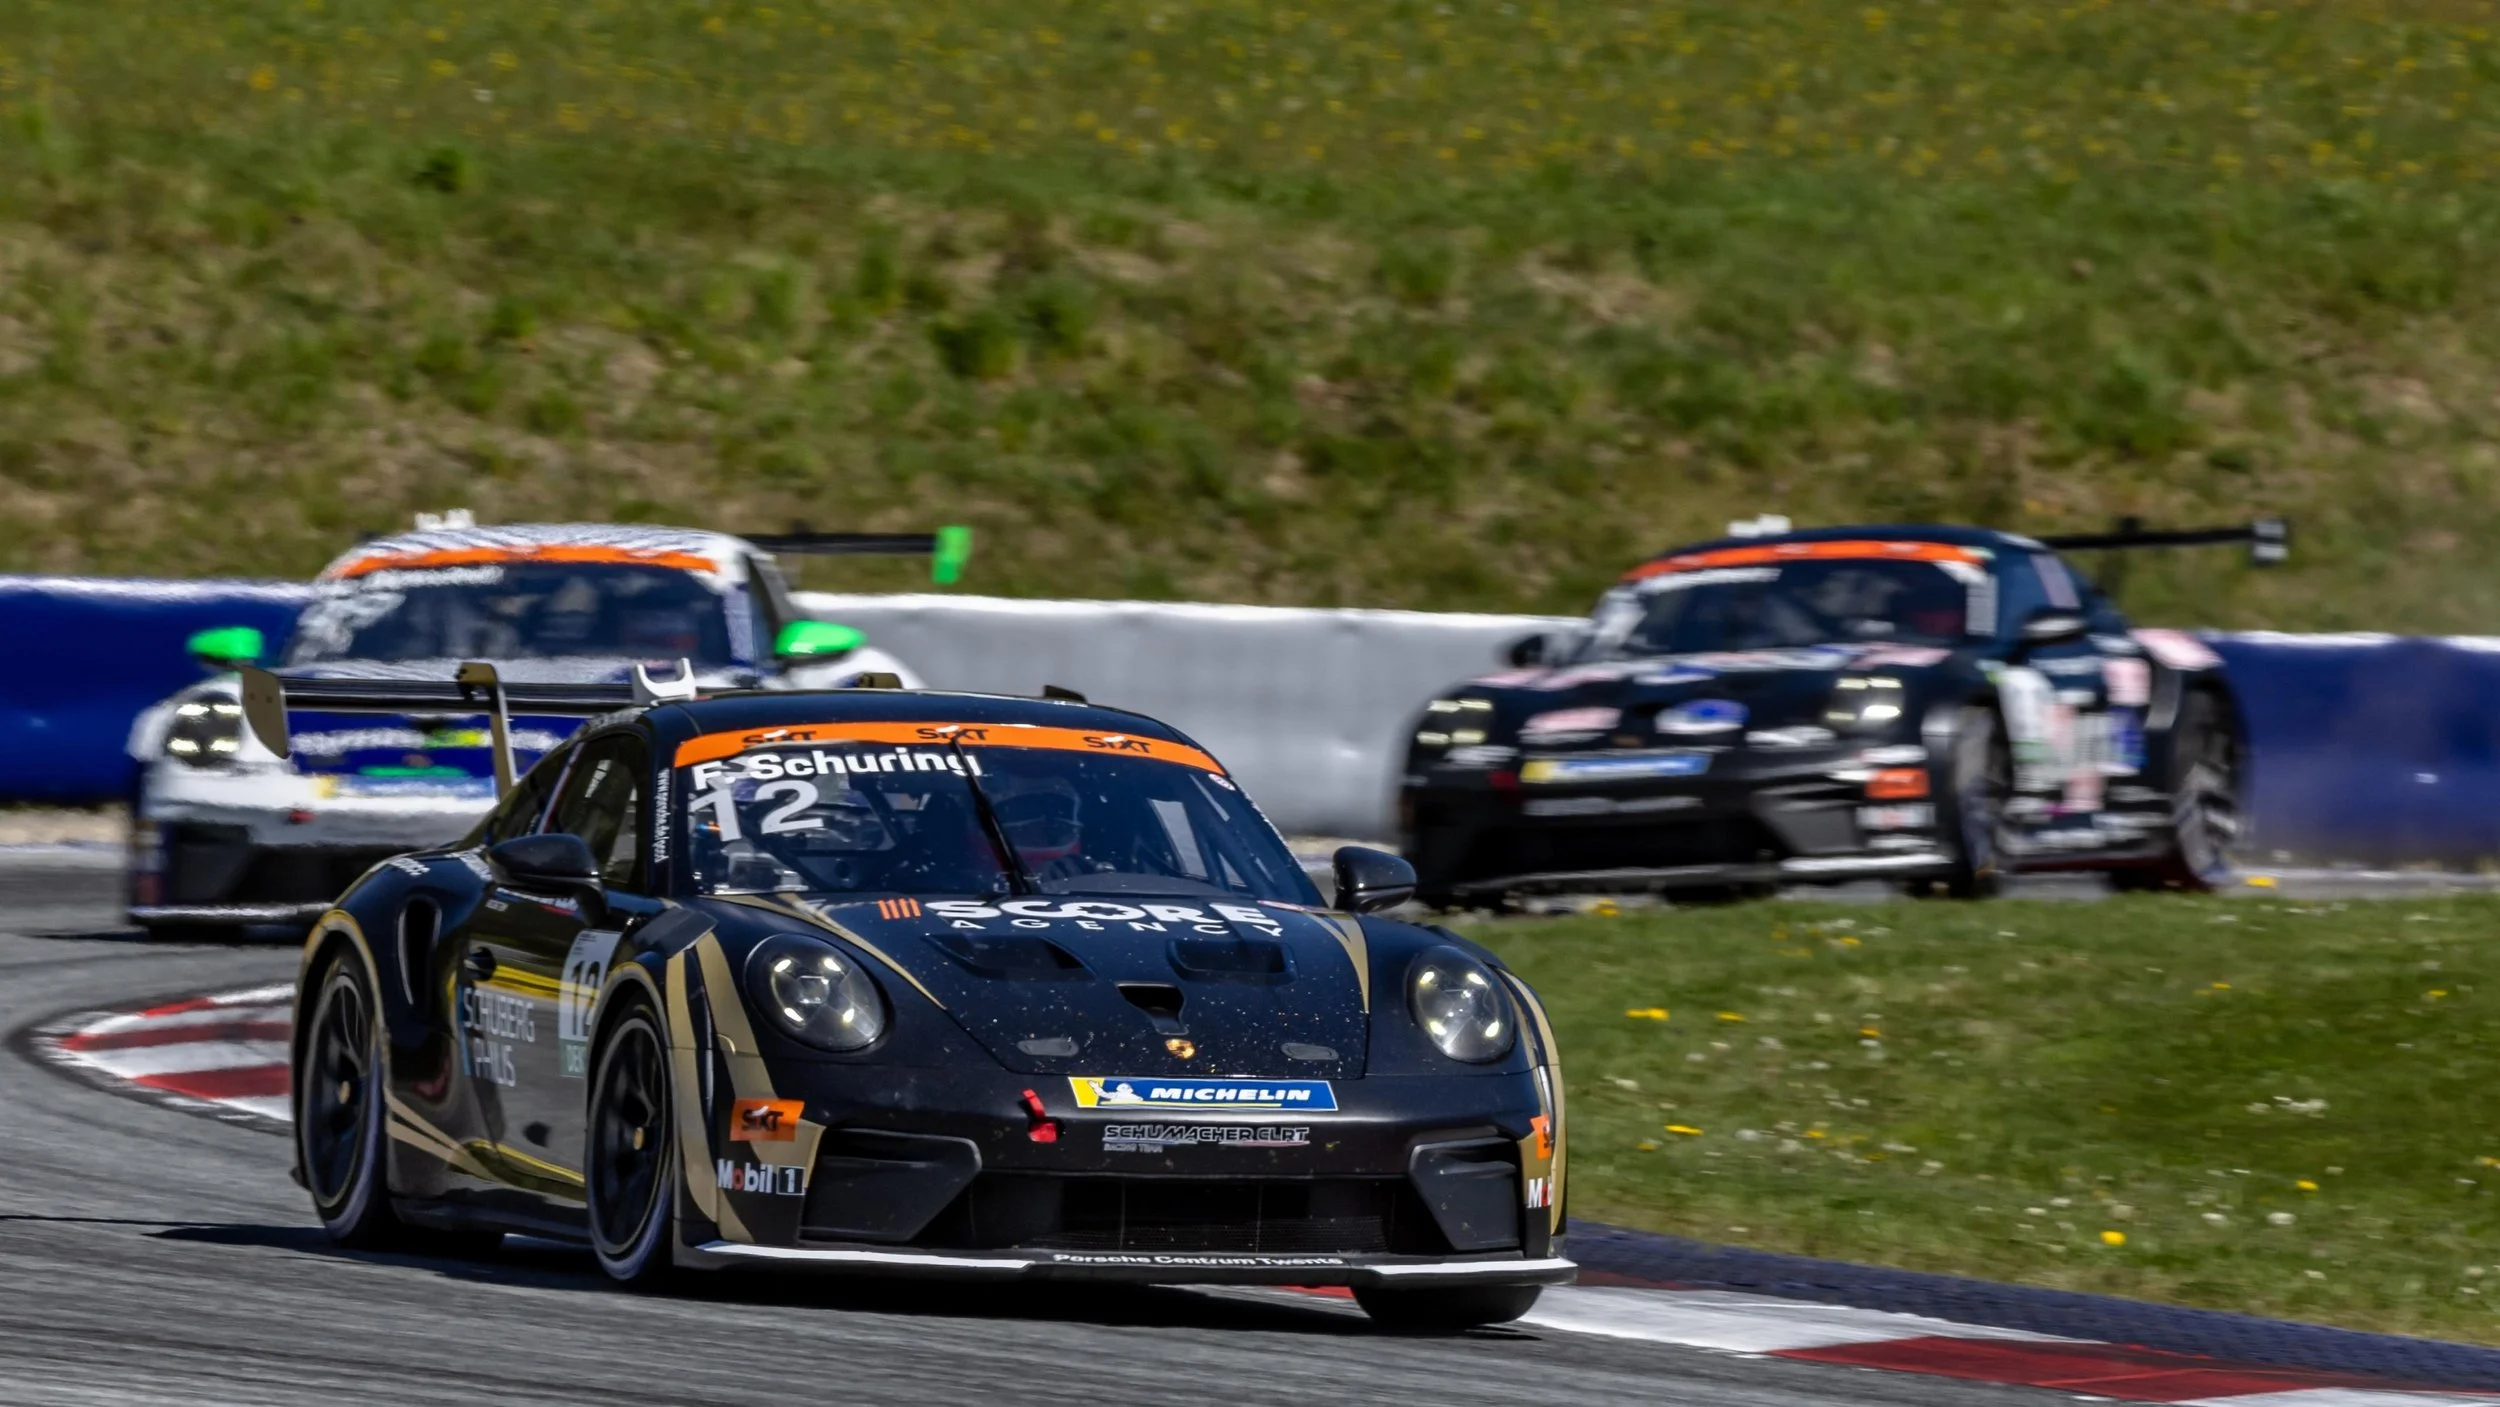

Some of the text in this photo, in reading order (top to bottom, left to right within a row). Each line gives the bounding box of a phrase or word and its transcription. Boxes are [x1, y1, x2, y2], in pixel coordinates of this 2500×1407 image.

[693, 748, 982, 790] F. Schuring
[690, 779, 824, 842] 12
[924, 900, 1280, 926] SCORE
[951, 918, 1283, 937] AGENCY
[1150, 1087, 1311, 1101] MICHELIN
[1103, 1125, 1310, 1143] SCHUMACHER CLRT
[717, 1160, 774, 1194] Mobil
[1053, 1253, 1344, 1265] Porsche Centrum Twente
